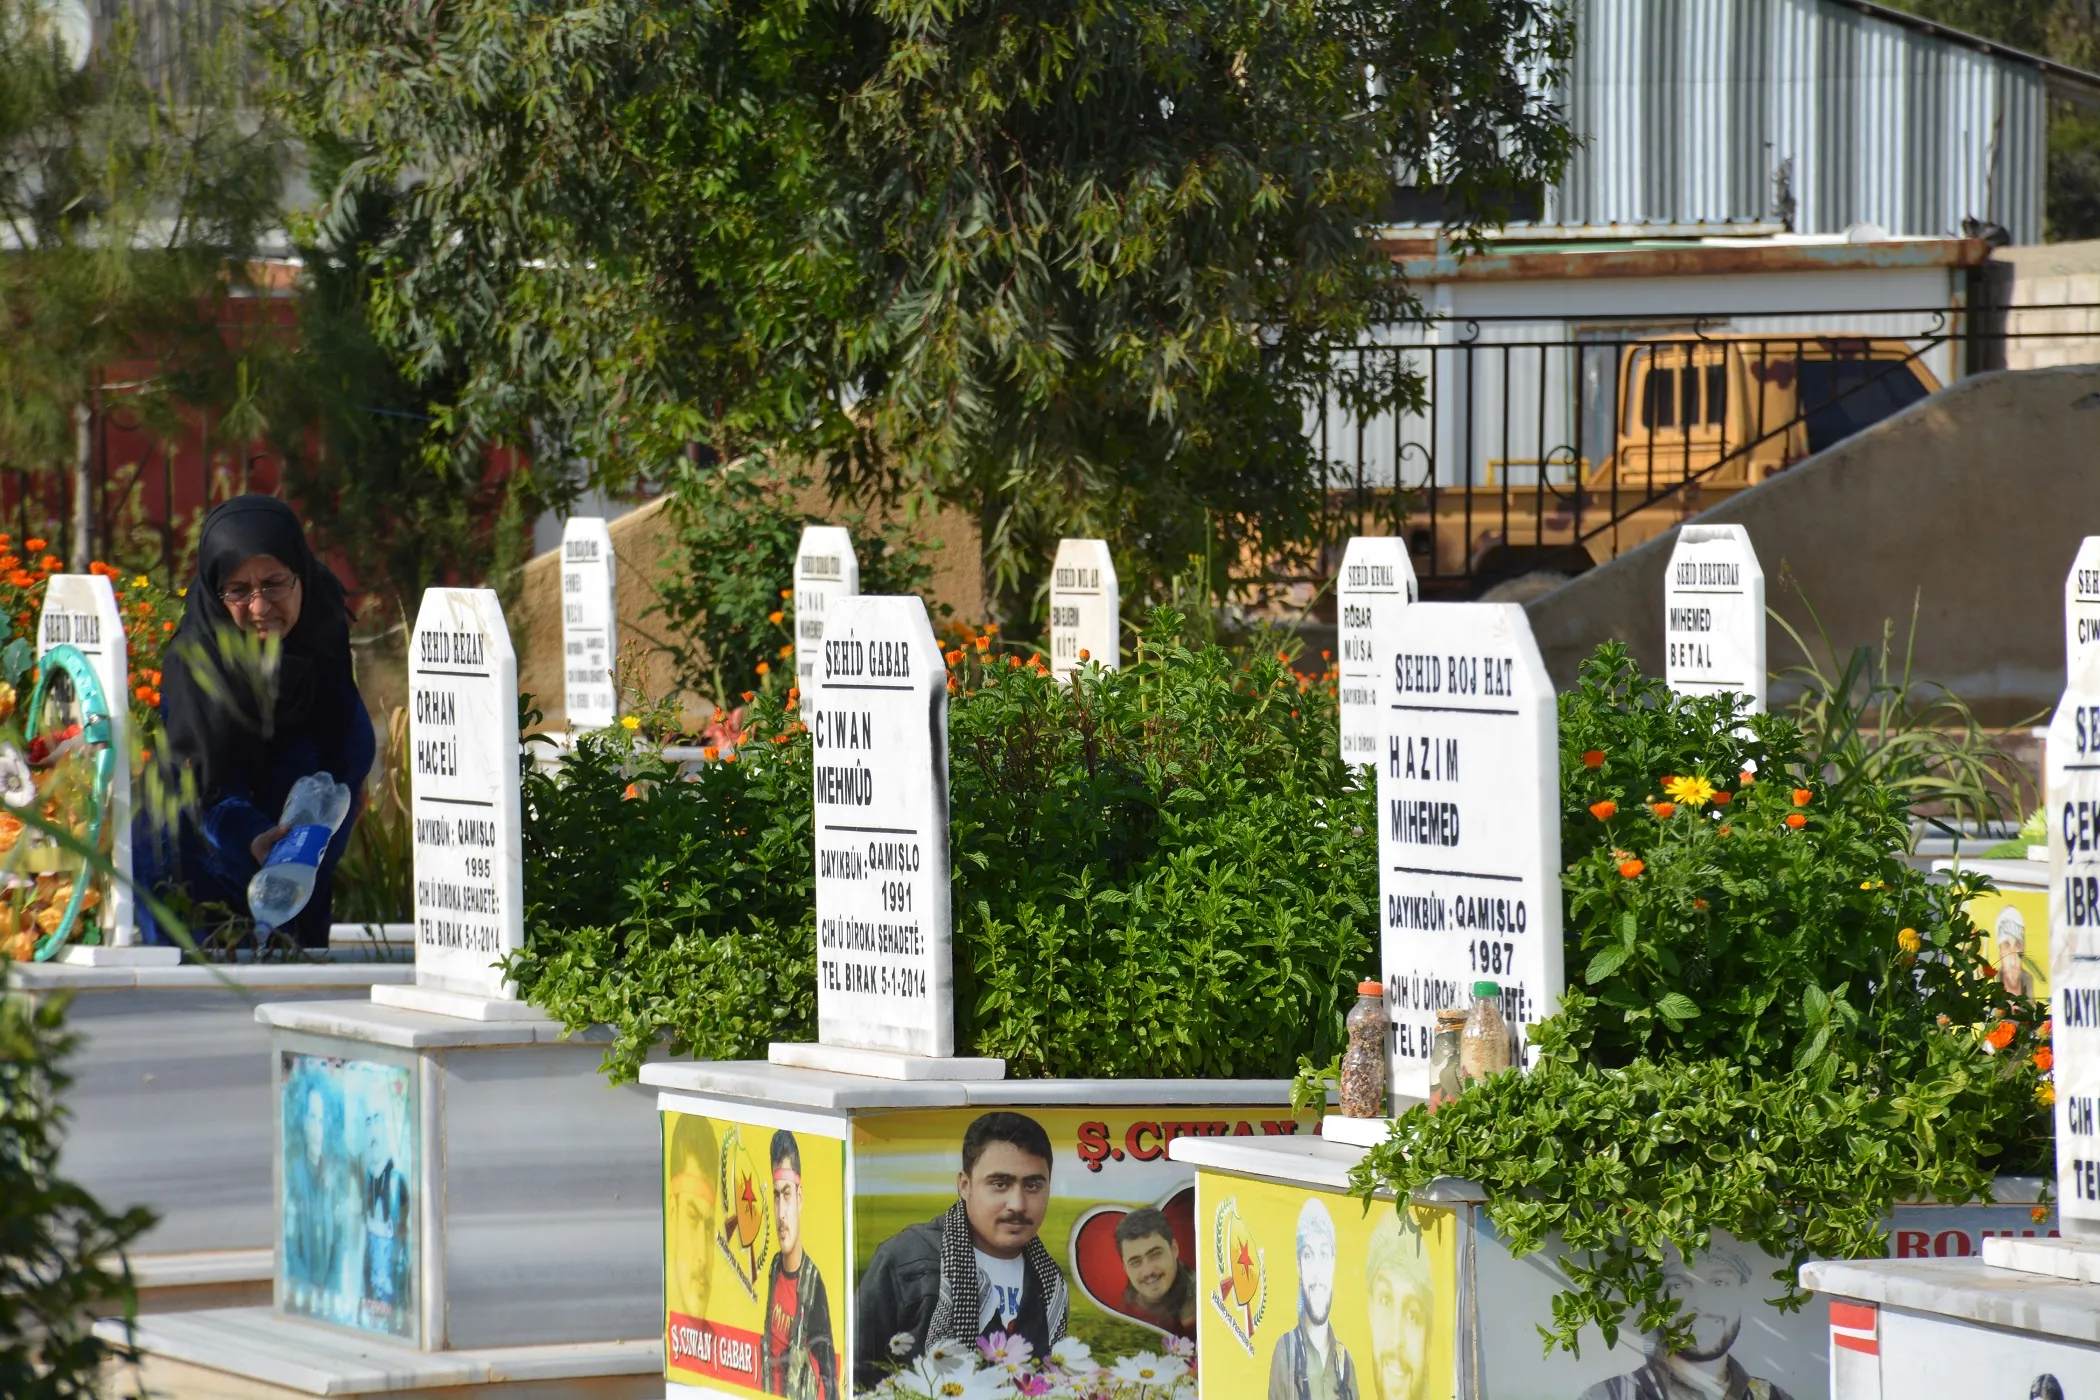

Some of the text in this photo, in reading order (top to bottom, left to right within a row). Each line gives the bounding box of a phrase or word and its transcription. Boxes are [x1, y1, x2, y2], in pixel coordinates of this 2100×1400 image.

[1670, 607, 1711, 632] MIHEMED
[868, 640, 910, 678] GABAR
[1670, 643, 1712, 668] BETAL
[1484, 657, 1513, 697] HAT
[416, 689, 455, 726] ORHAN
[816, 709, 871, 750] CIWAN
[1390, 735, 1458, 783] HAZIM
[817, 758, 872, 807] MEHMÛD
[1391, 799, 1459, 847] MIHEMED
[465, 857, 490, 878] 1995
[869, 841, 920, 876] QAMIŞLO
[882, 880, 912, 912] 1991
[420, 918, 435, 946] TEL
[438, 920, 463, 949] BIRAK
[822, 918, 836, 949] CIH
[846, 915, 876, 952] DÎROKA
[1455, 894, 1526, 938] QAMIŞLO
[1468, 939, 1514, 976] 1987
[822, 961, 926, 999] TEL BIRAK 5-1-2014
[1391, 1021, 1415, 1058] TEL
[2069, 1096, 2094, 1137] CIH
[672, 1323, 712, 1362] Ş.CIWAN
